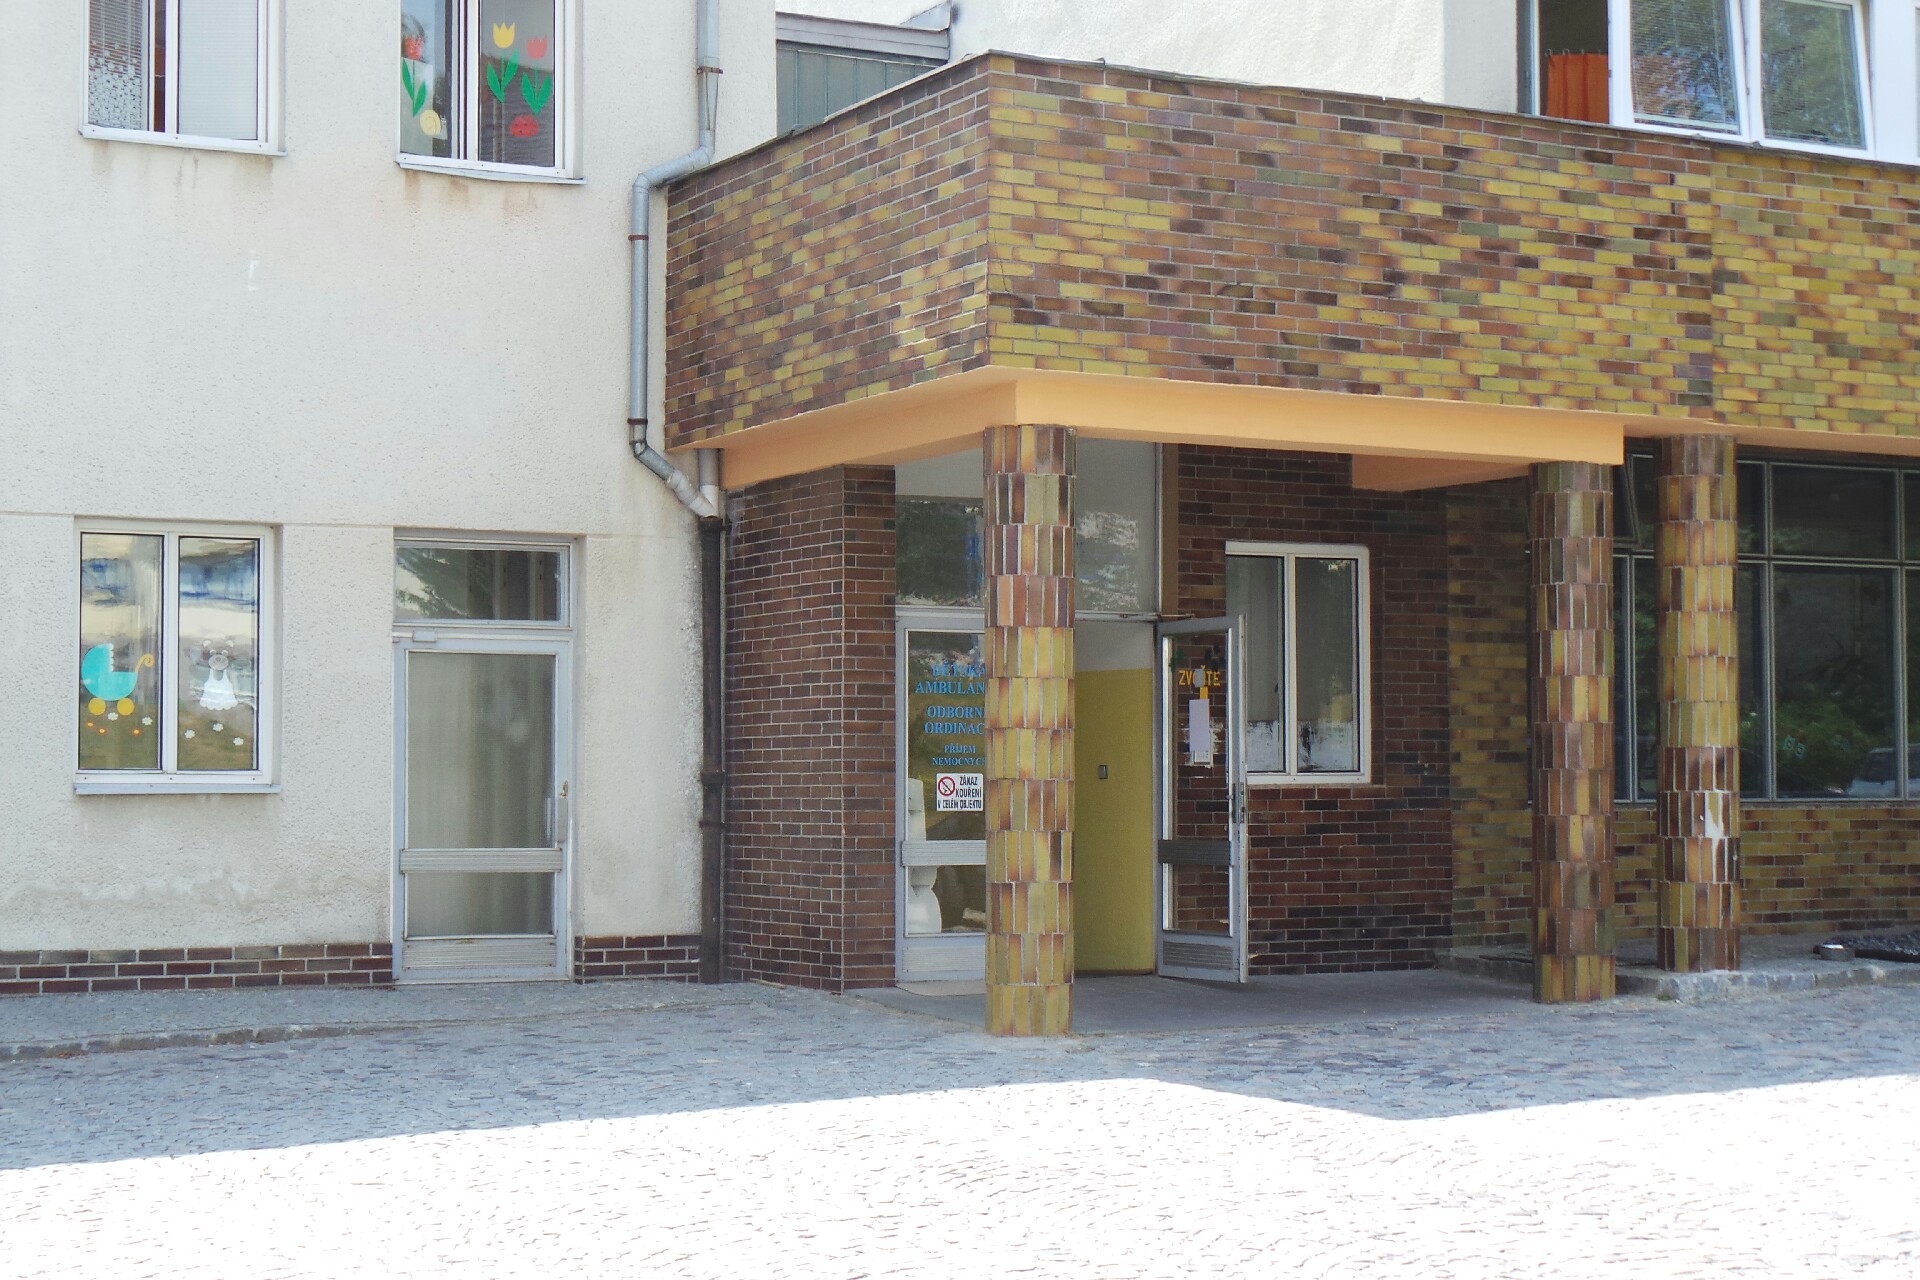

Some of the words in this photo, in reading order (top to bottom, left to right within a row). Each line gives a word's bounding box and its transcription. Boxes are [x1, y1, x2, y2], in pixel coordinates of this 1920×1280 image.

[1179, 665, 1220, 686] ZVTE
[915, 681, 985, 694] AMBULAN
[927, 705, 985, 718] ODBORN
[924, 722, 985, 735] ORDINAC
[959, 775, 978, 786] ZÁKAZ
[960, 800, 982, 809] OBJEKTU
